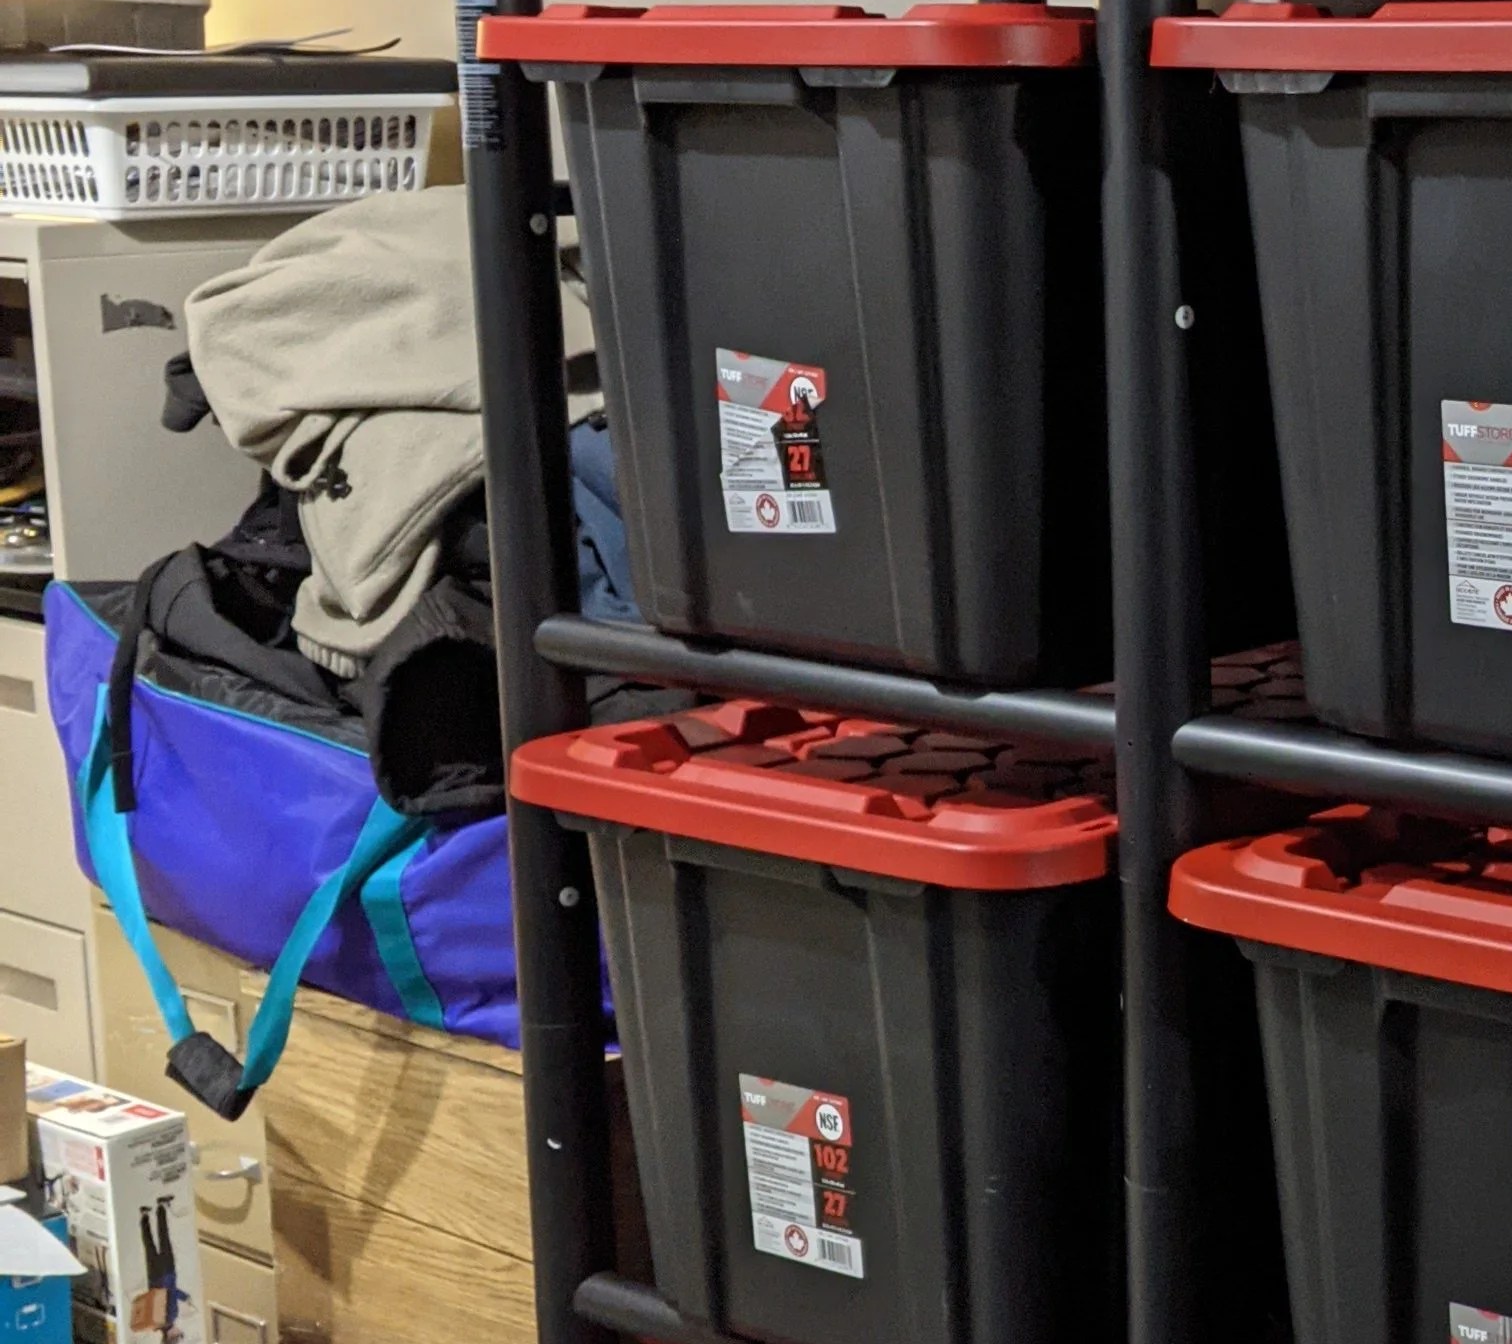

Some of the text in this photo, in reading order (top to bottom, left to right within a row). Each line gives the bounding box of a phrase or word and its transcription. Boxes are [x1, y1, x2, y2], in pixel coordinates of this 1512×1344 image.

[787, 445, 811, 472] 27
[819, 1112, 839, 1132] NSF
[814, 1143, 849, 1174] 102
[823, 1190, 847, 1218] 27
